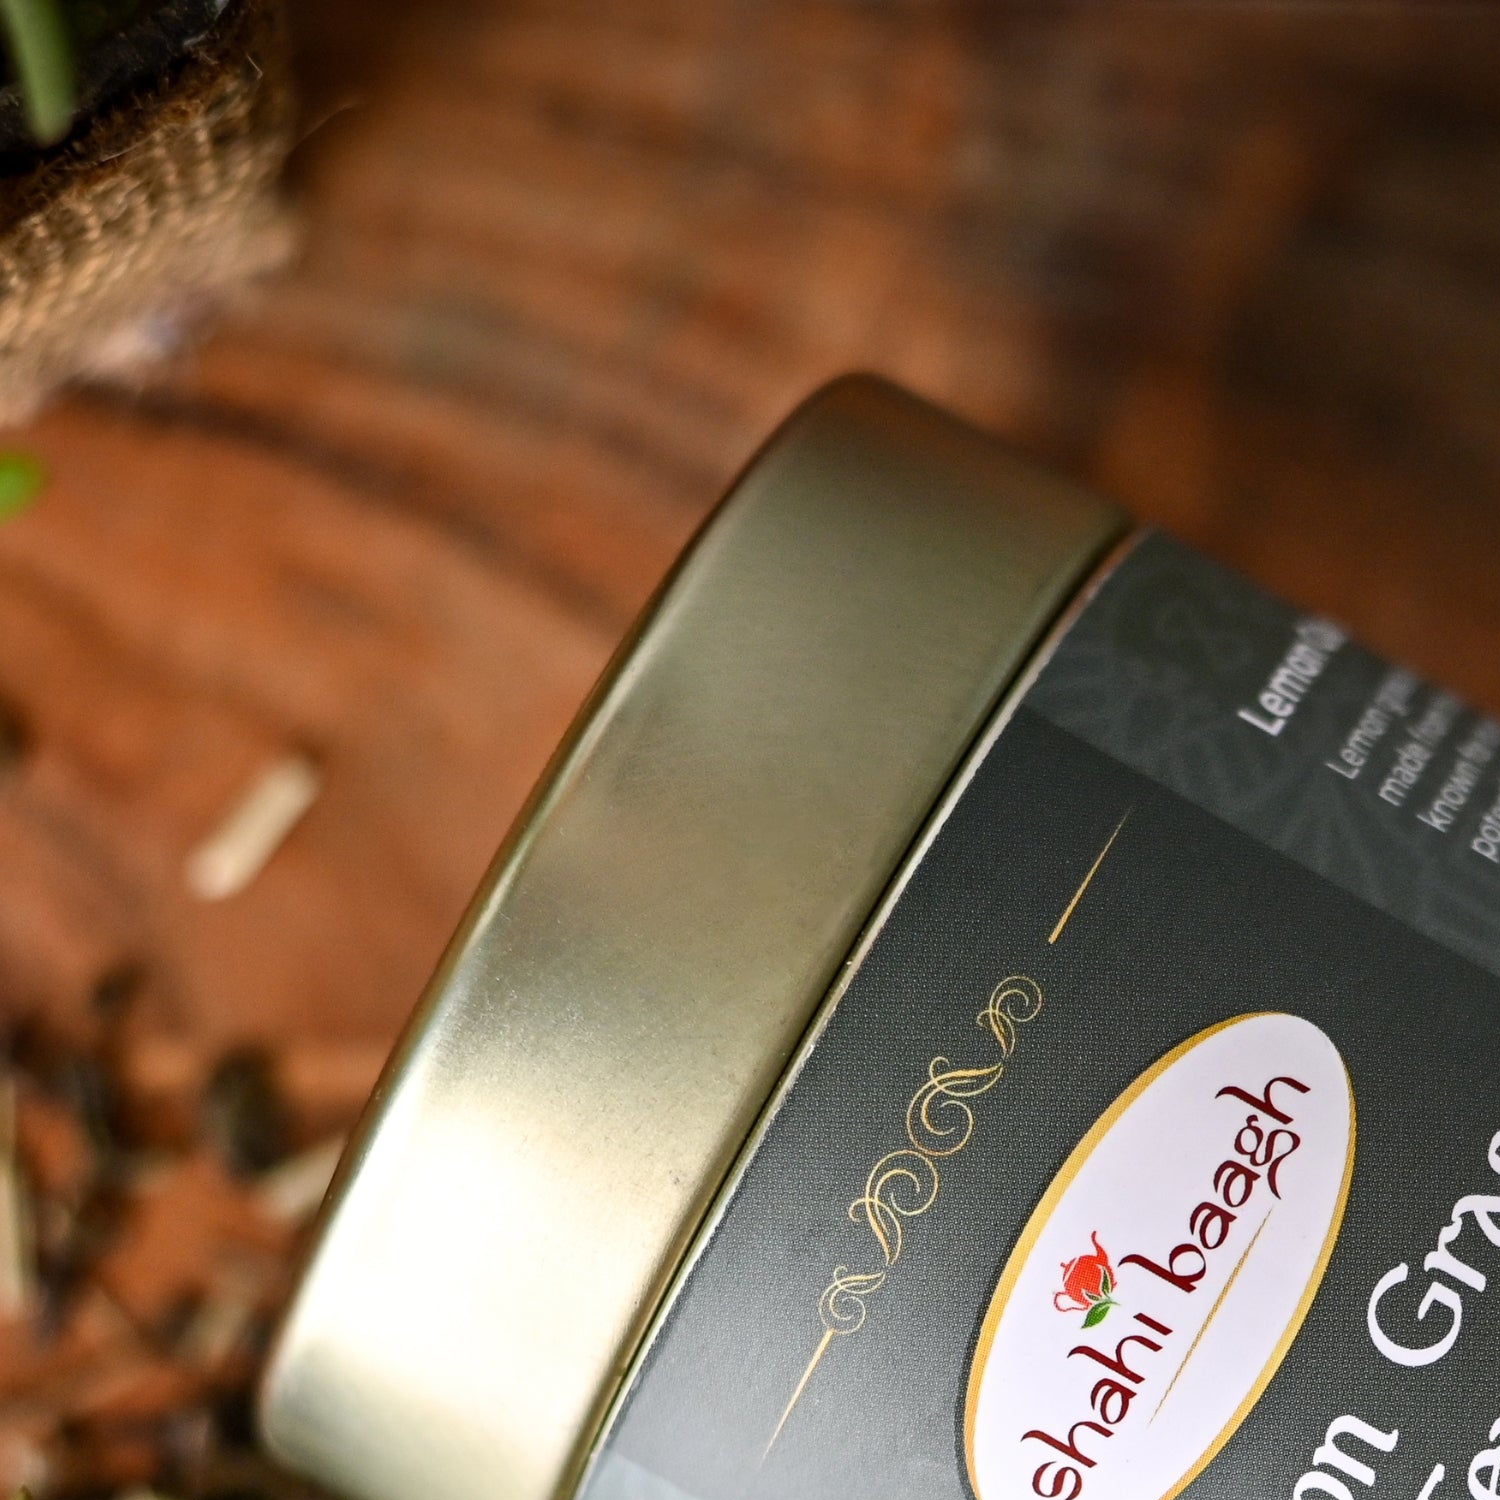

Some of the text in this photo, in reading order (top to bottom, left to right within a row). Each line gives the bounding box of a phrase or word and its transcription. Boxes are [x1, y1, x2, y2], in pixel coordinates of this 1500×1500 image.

[1238, 643, 1327, 736] Lemon
[1326, 708, 1387, 779] Lemon
[1379, 743, 1430, 806] made
[1417, 761, 1474, 832] known
[1118, 1075, 1311, 1294] baagh
